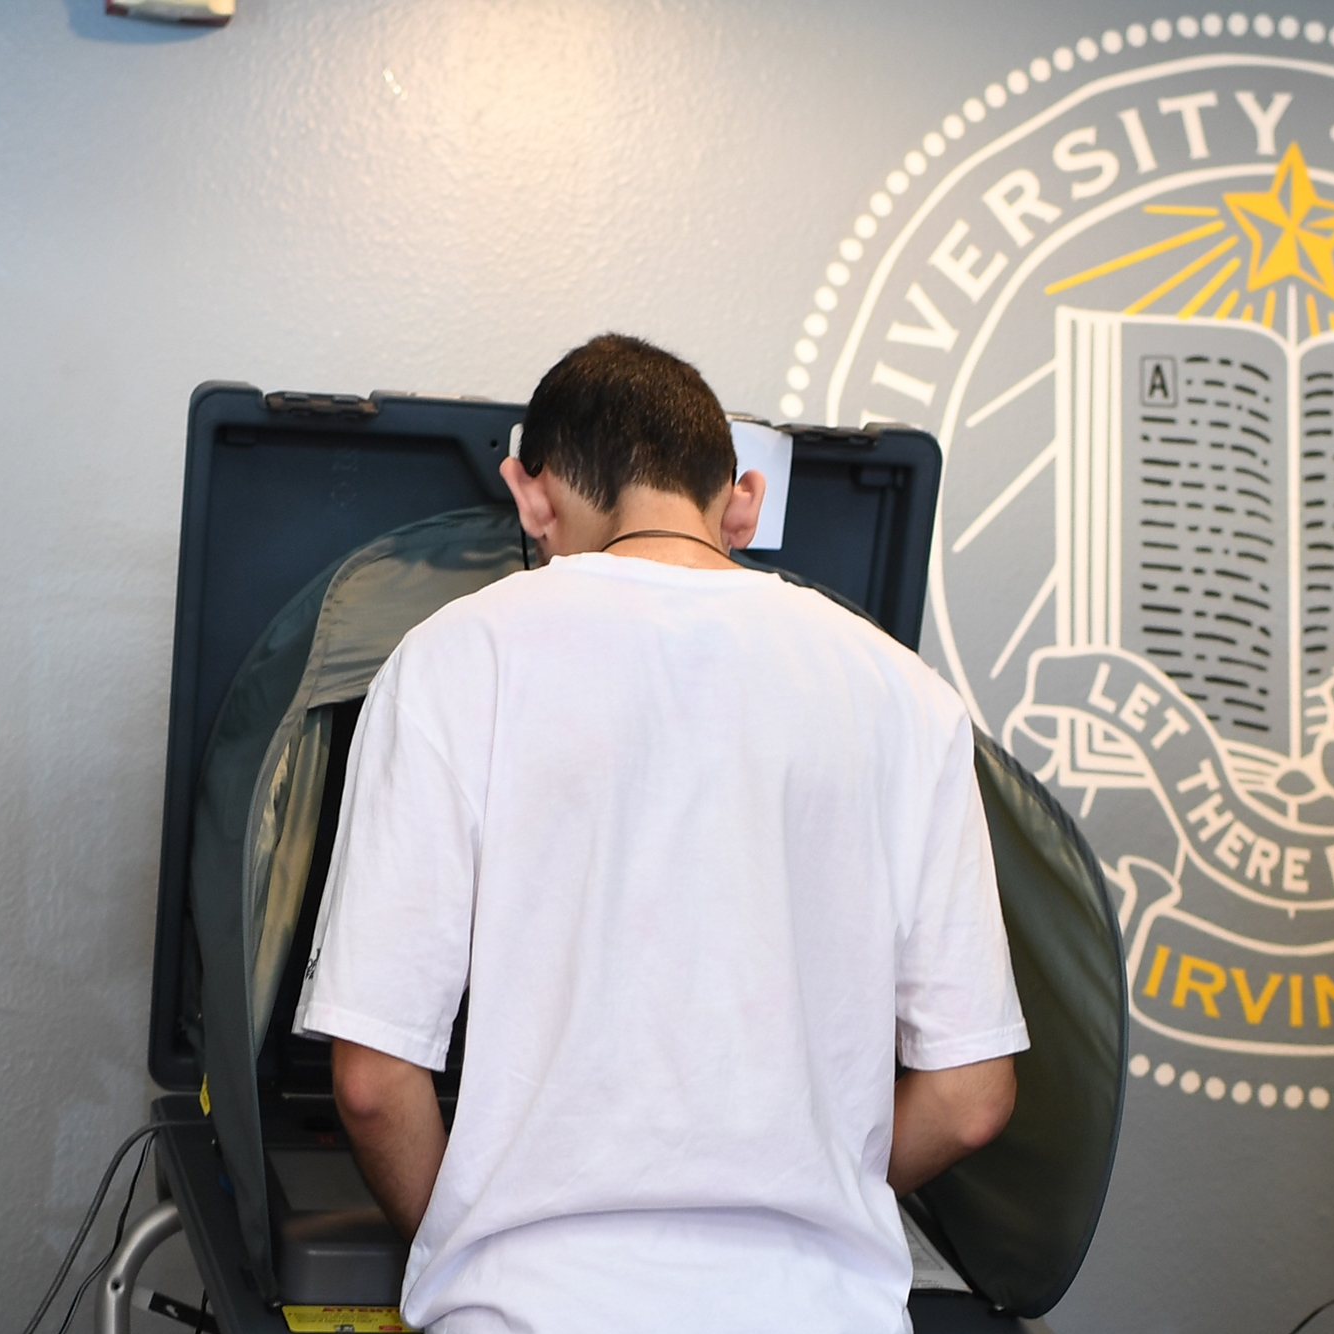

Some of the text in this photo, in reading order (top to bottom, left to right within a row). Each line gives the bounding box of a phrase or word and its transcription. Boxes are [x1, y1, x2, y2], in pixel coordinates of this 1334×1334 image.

[859, 91, 1293, 430] IVERSITY
[1149, 363, 1168, 398] A
[1087, 663, 1191, 750] LET
[1176, 758, 1310, 892] THERE
